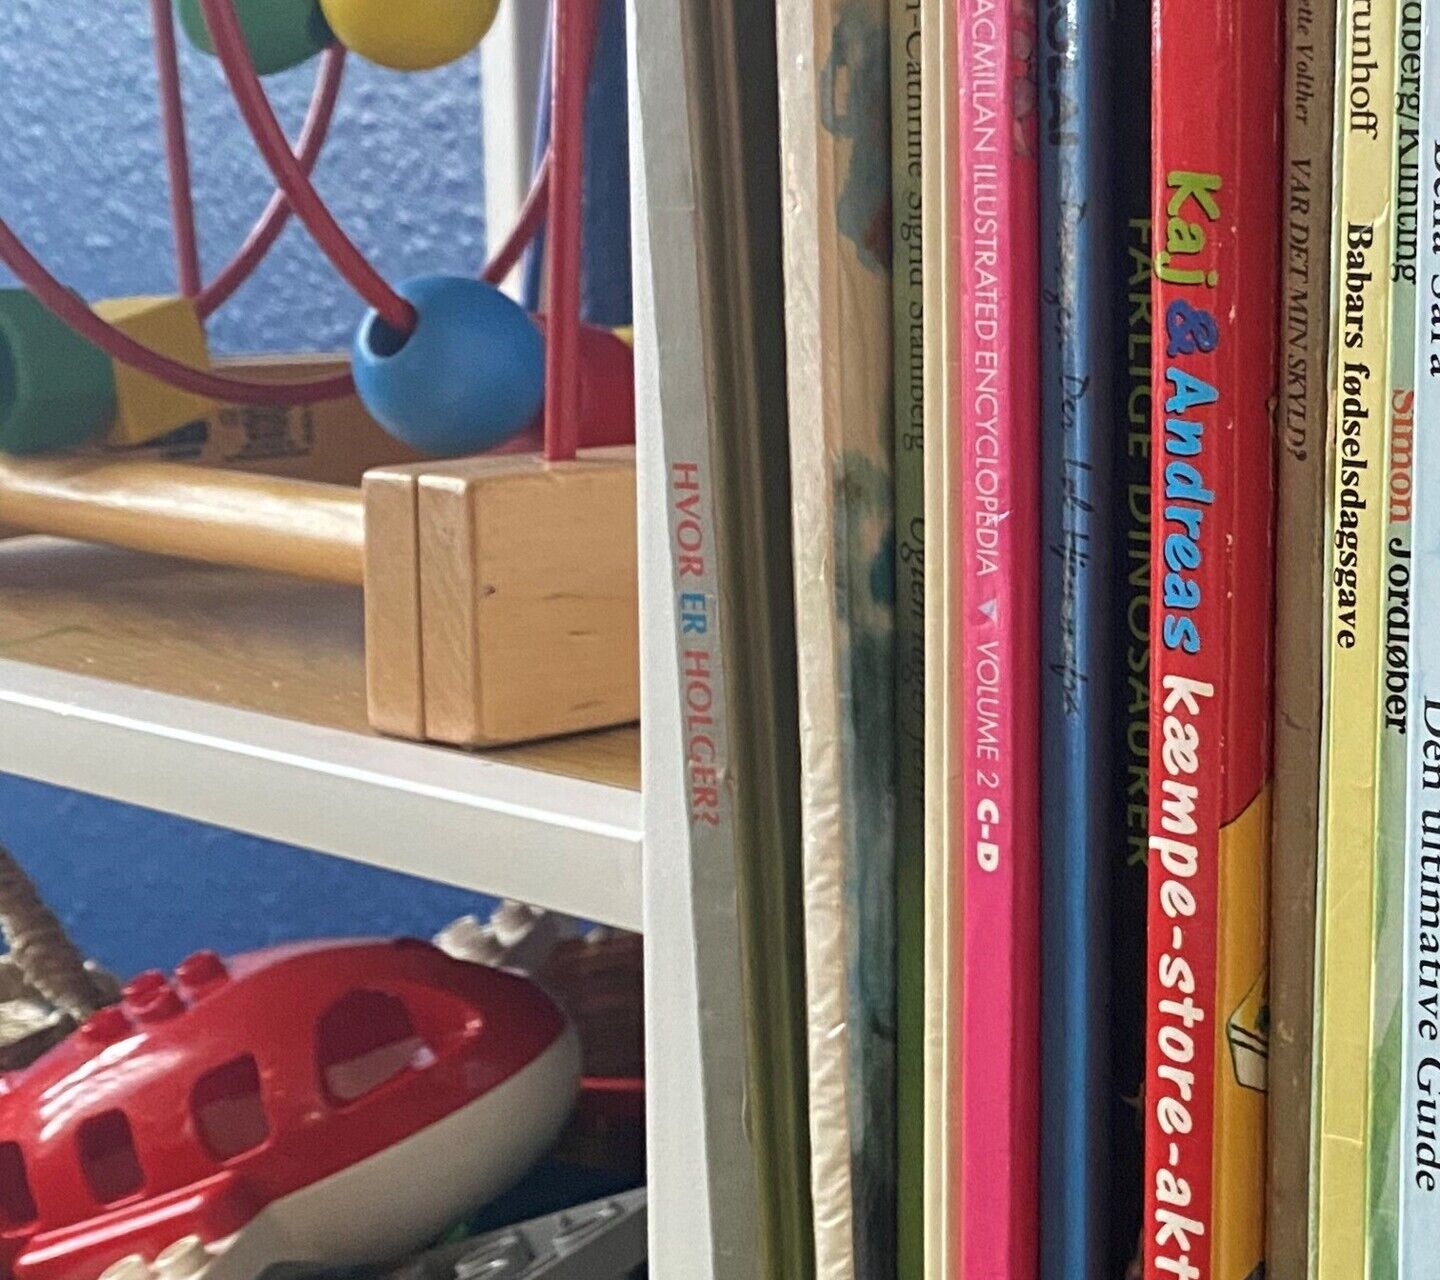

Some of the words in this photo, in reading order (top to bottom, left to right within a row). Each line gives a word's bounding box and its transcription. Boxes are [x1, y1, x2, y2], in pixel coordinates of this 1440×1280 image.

[1295, 44, 1314, 125] Volther
[1154, 170, 1223, 287] Kaj
[1289, 158, 1312, 214] VAR
[972, 164, 999, 340] ILLUSTRATED
[1288, 222, 1312, 283] DET
[1345, 221, 1375, 348] Babars
[1165, 299, 1221, 358] &
[1288, 289, 1309, 351] MIN
[974, 351, 1000, 576] ENCYCLOPEDIA
[1285, 353, 1308, 461] SKYLD?
[1389, 388, 1414, 524] Simon
[672, 462, 704, 577] HVOR
[1163, 366, 1220, 653] Andreas
[1334, 362, 1371, 649] fødselsdagsgave
[680, 592, 709, 635] ER
[683, 649, 720, 827] HOLGER?
[975, 640, 1000, 760] VOLUME
[975, 769, 1000, 788] 2
[976, 797, 1001, 872] C-D
